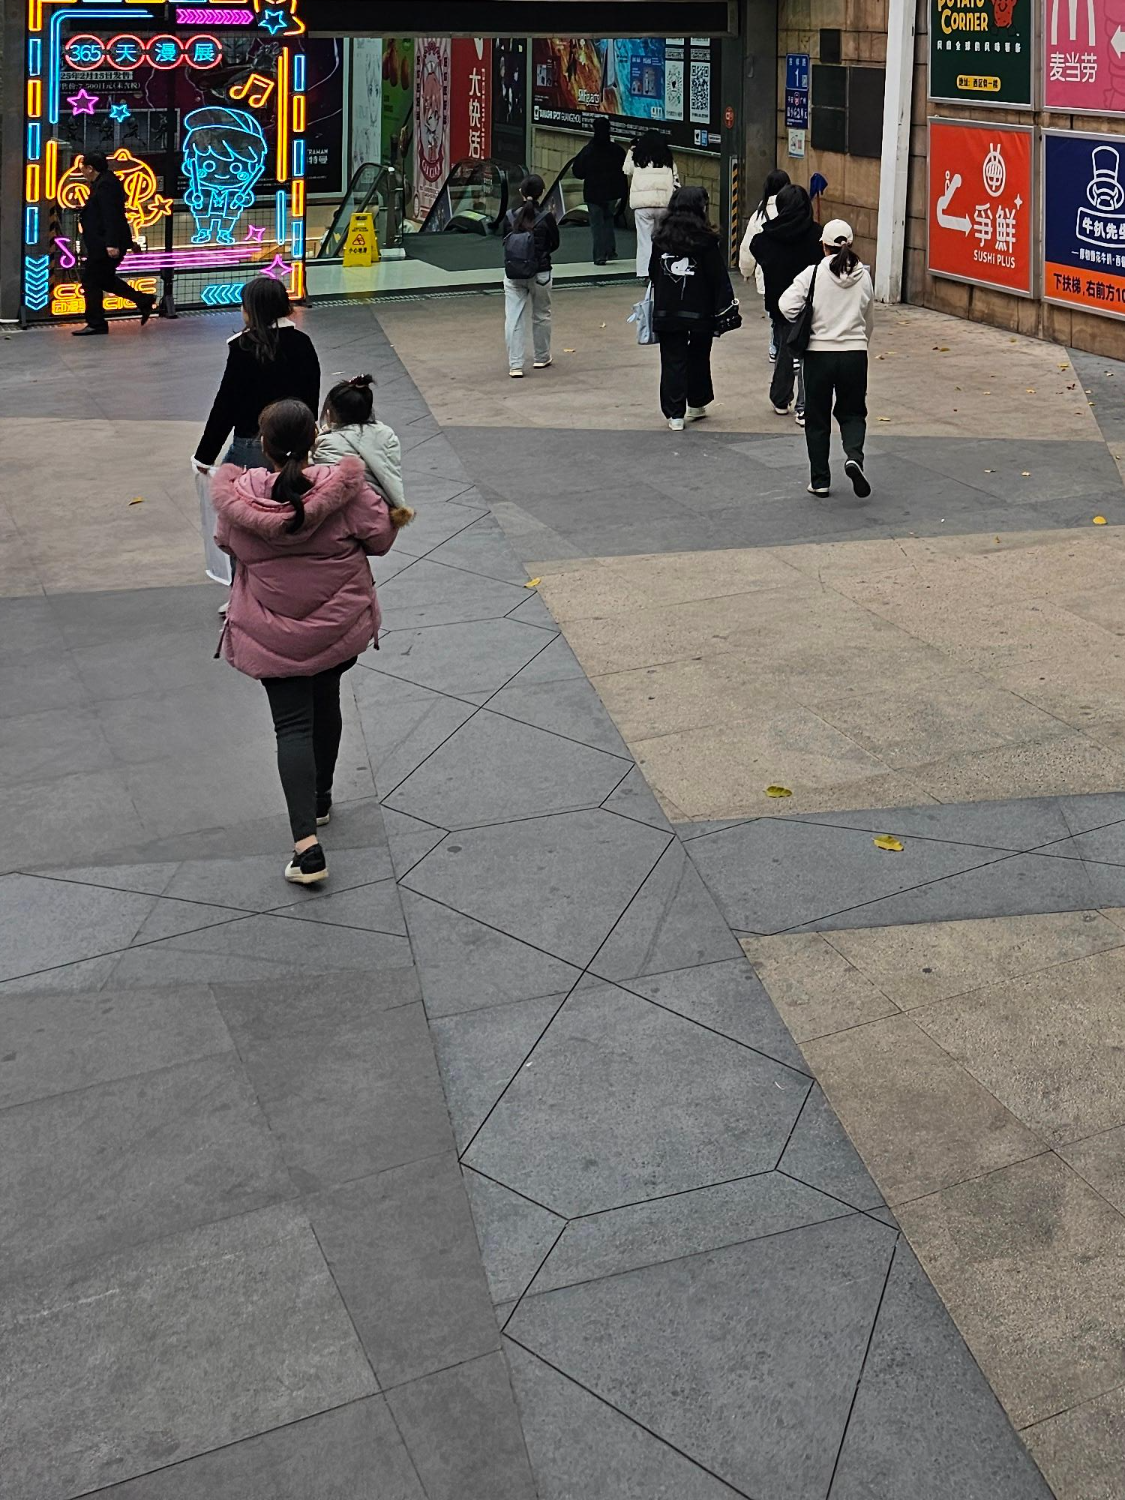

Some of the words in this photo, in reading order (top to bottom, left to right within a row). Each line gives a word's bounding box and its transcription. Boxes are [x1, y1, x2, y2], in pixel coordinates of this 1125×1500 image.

[941, 8, 989, 35] CORNER
[1050, 51, 1097, 83] 麦当劳
[469, 67, 481, 159] 大快活
[997, 256, 1015, 269] PLUS
